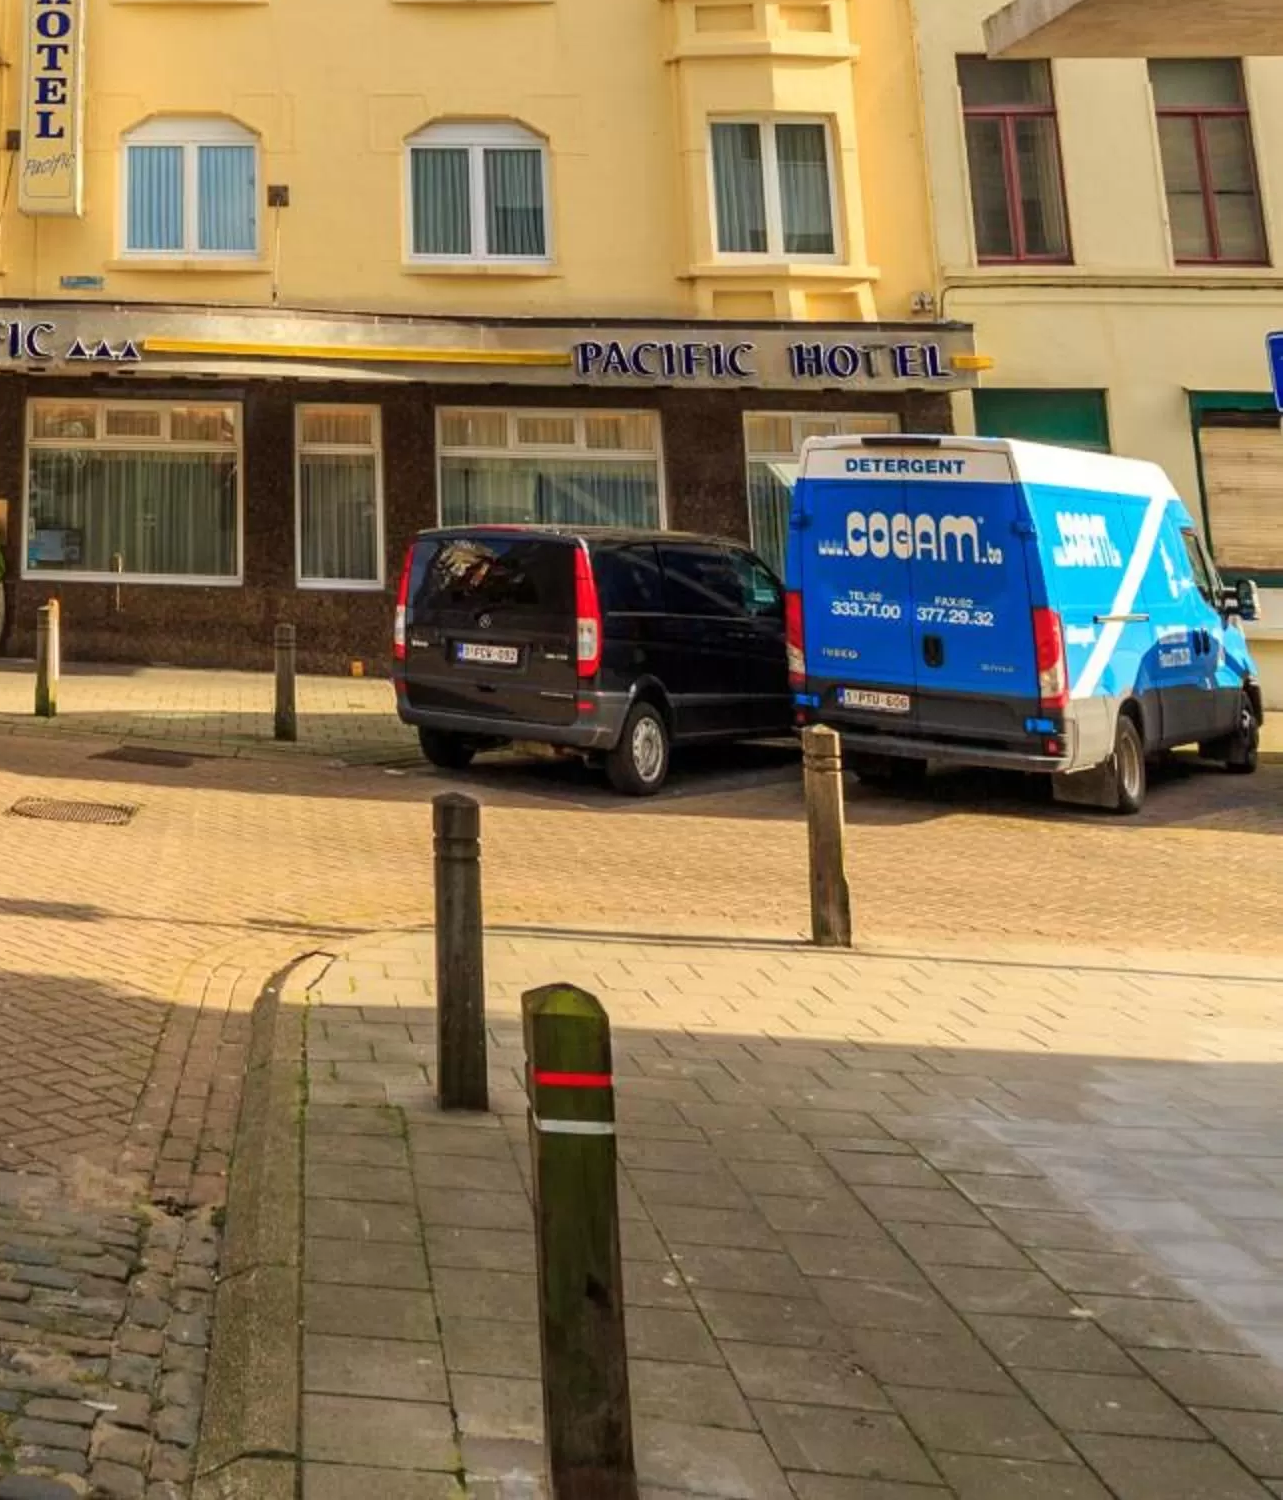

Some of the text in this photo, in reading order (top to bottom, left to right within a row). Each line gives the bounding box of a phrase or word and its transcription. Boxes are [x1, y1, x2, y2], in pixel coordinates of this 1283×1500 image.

[577, 341, 953, 380] PACIFIC HOTEL
[845, 458, 965, 474] DETERGENT
[831, 601, 901, 619] 333.71.00
[917, 607, 994, 627] 377.29.32
